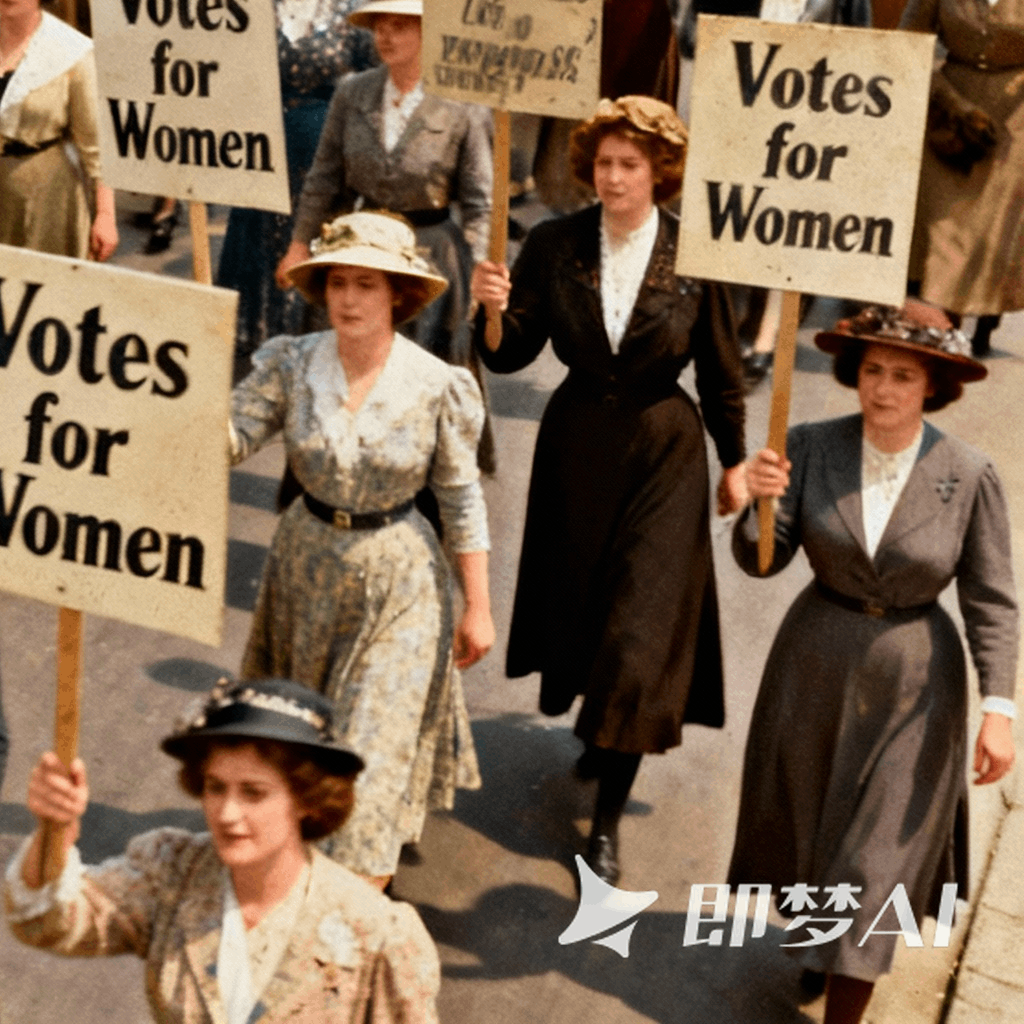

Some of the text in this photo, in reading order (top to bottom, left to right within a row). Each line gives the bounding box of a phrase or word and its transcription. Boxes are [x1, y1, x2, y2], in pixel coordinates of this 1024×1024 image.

[151, 40, 218, 97] for
[732, 41, 892, 117] Votes
[108, 98, 274, 172] Women
[763, 122, 848, 181] for
[707, 181, 893, 256] Women
[23, 392, 129, 476] for
